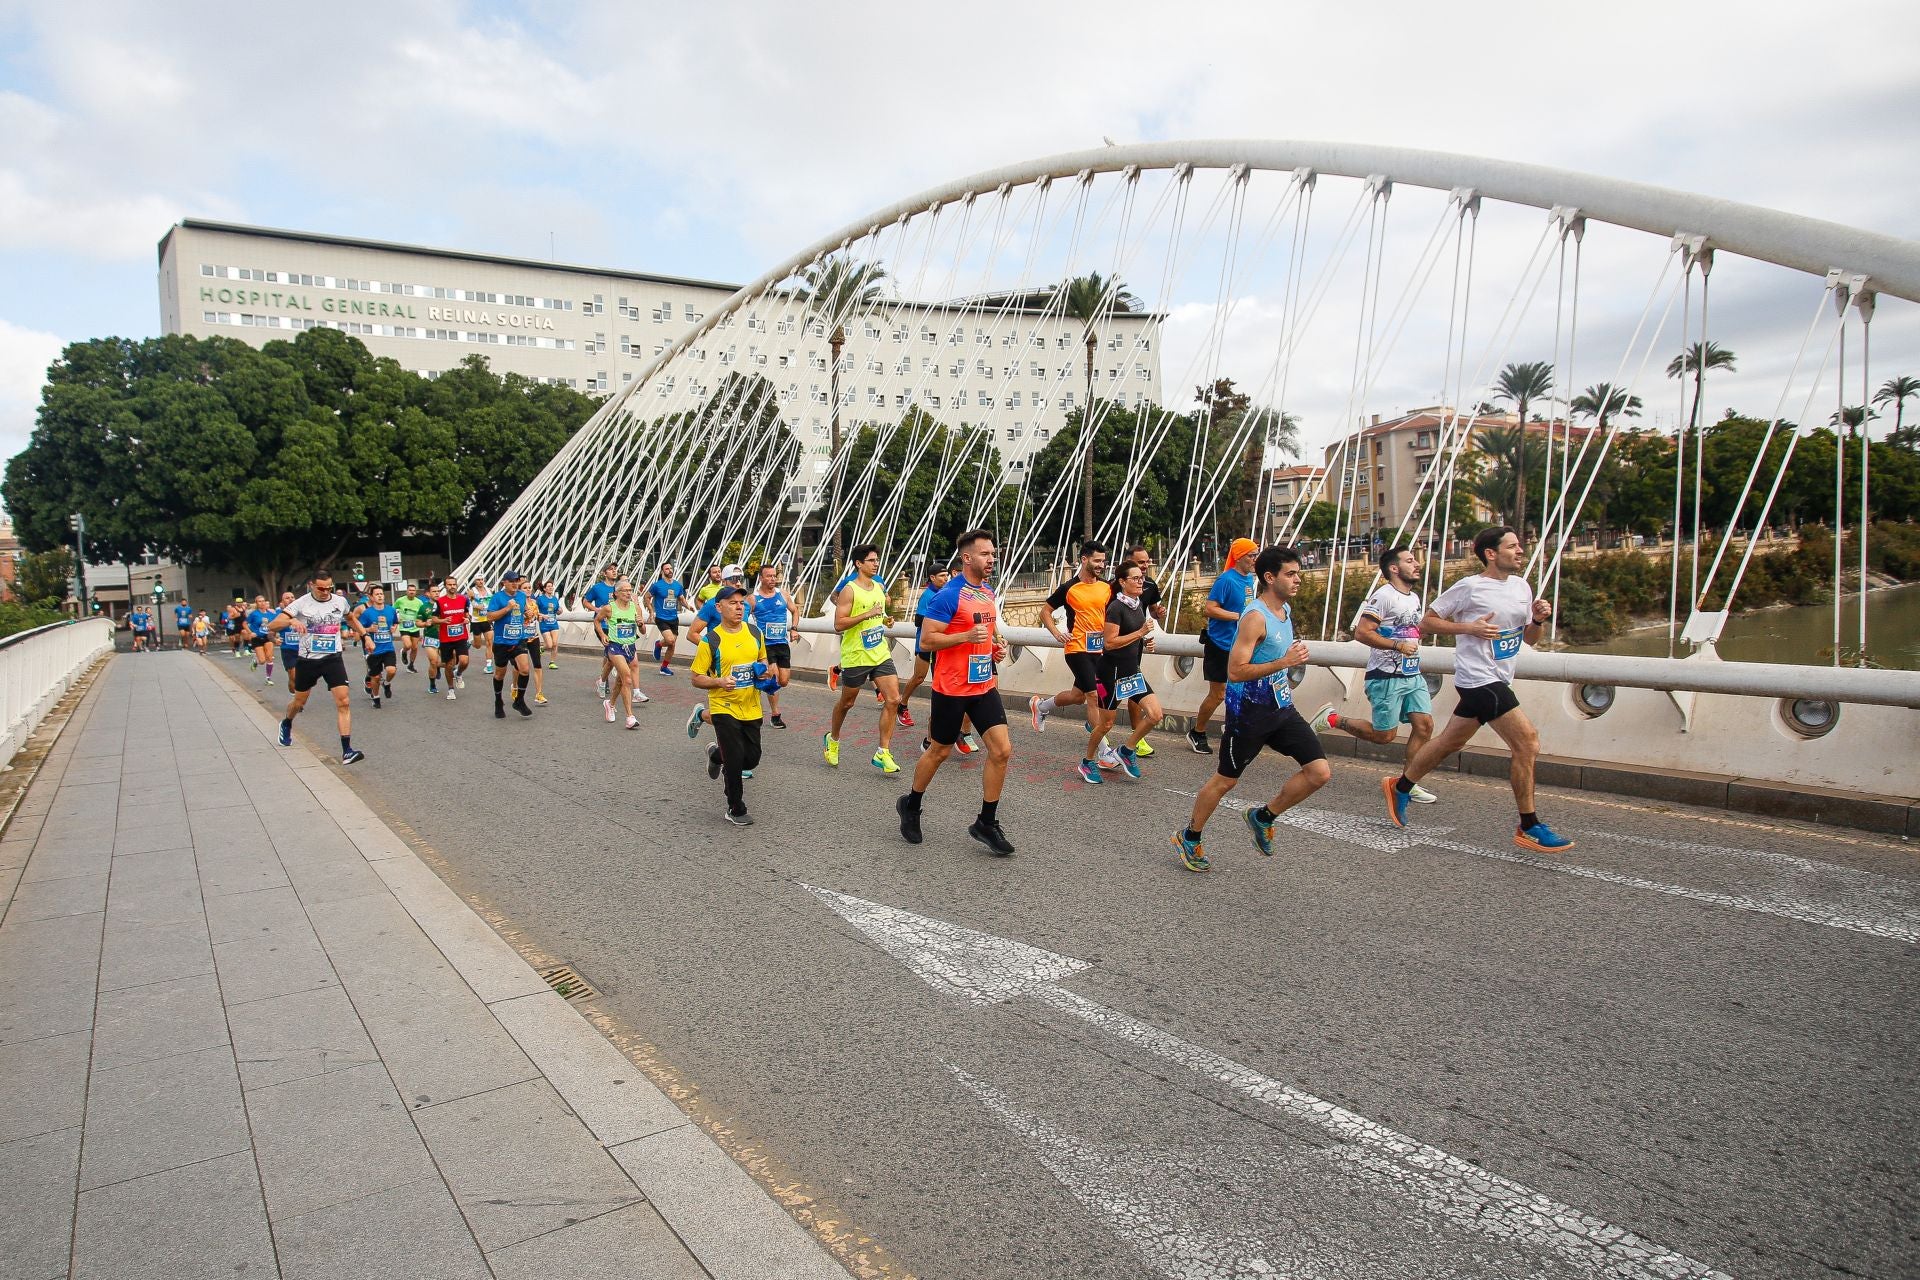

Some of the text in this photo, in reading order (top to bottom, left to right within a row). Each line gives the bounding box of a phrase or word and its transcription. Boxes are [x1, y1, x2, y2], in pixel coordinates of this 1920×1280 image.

[200, 286, 313, 311] HOSPITAL
[321, 298, 417, 319] GENERAL
[428, 305, 492, 326] REINA
[1499, 636, 1520, 651] 923
[1120, 680, 1139, 692] 891
